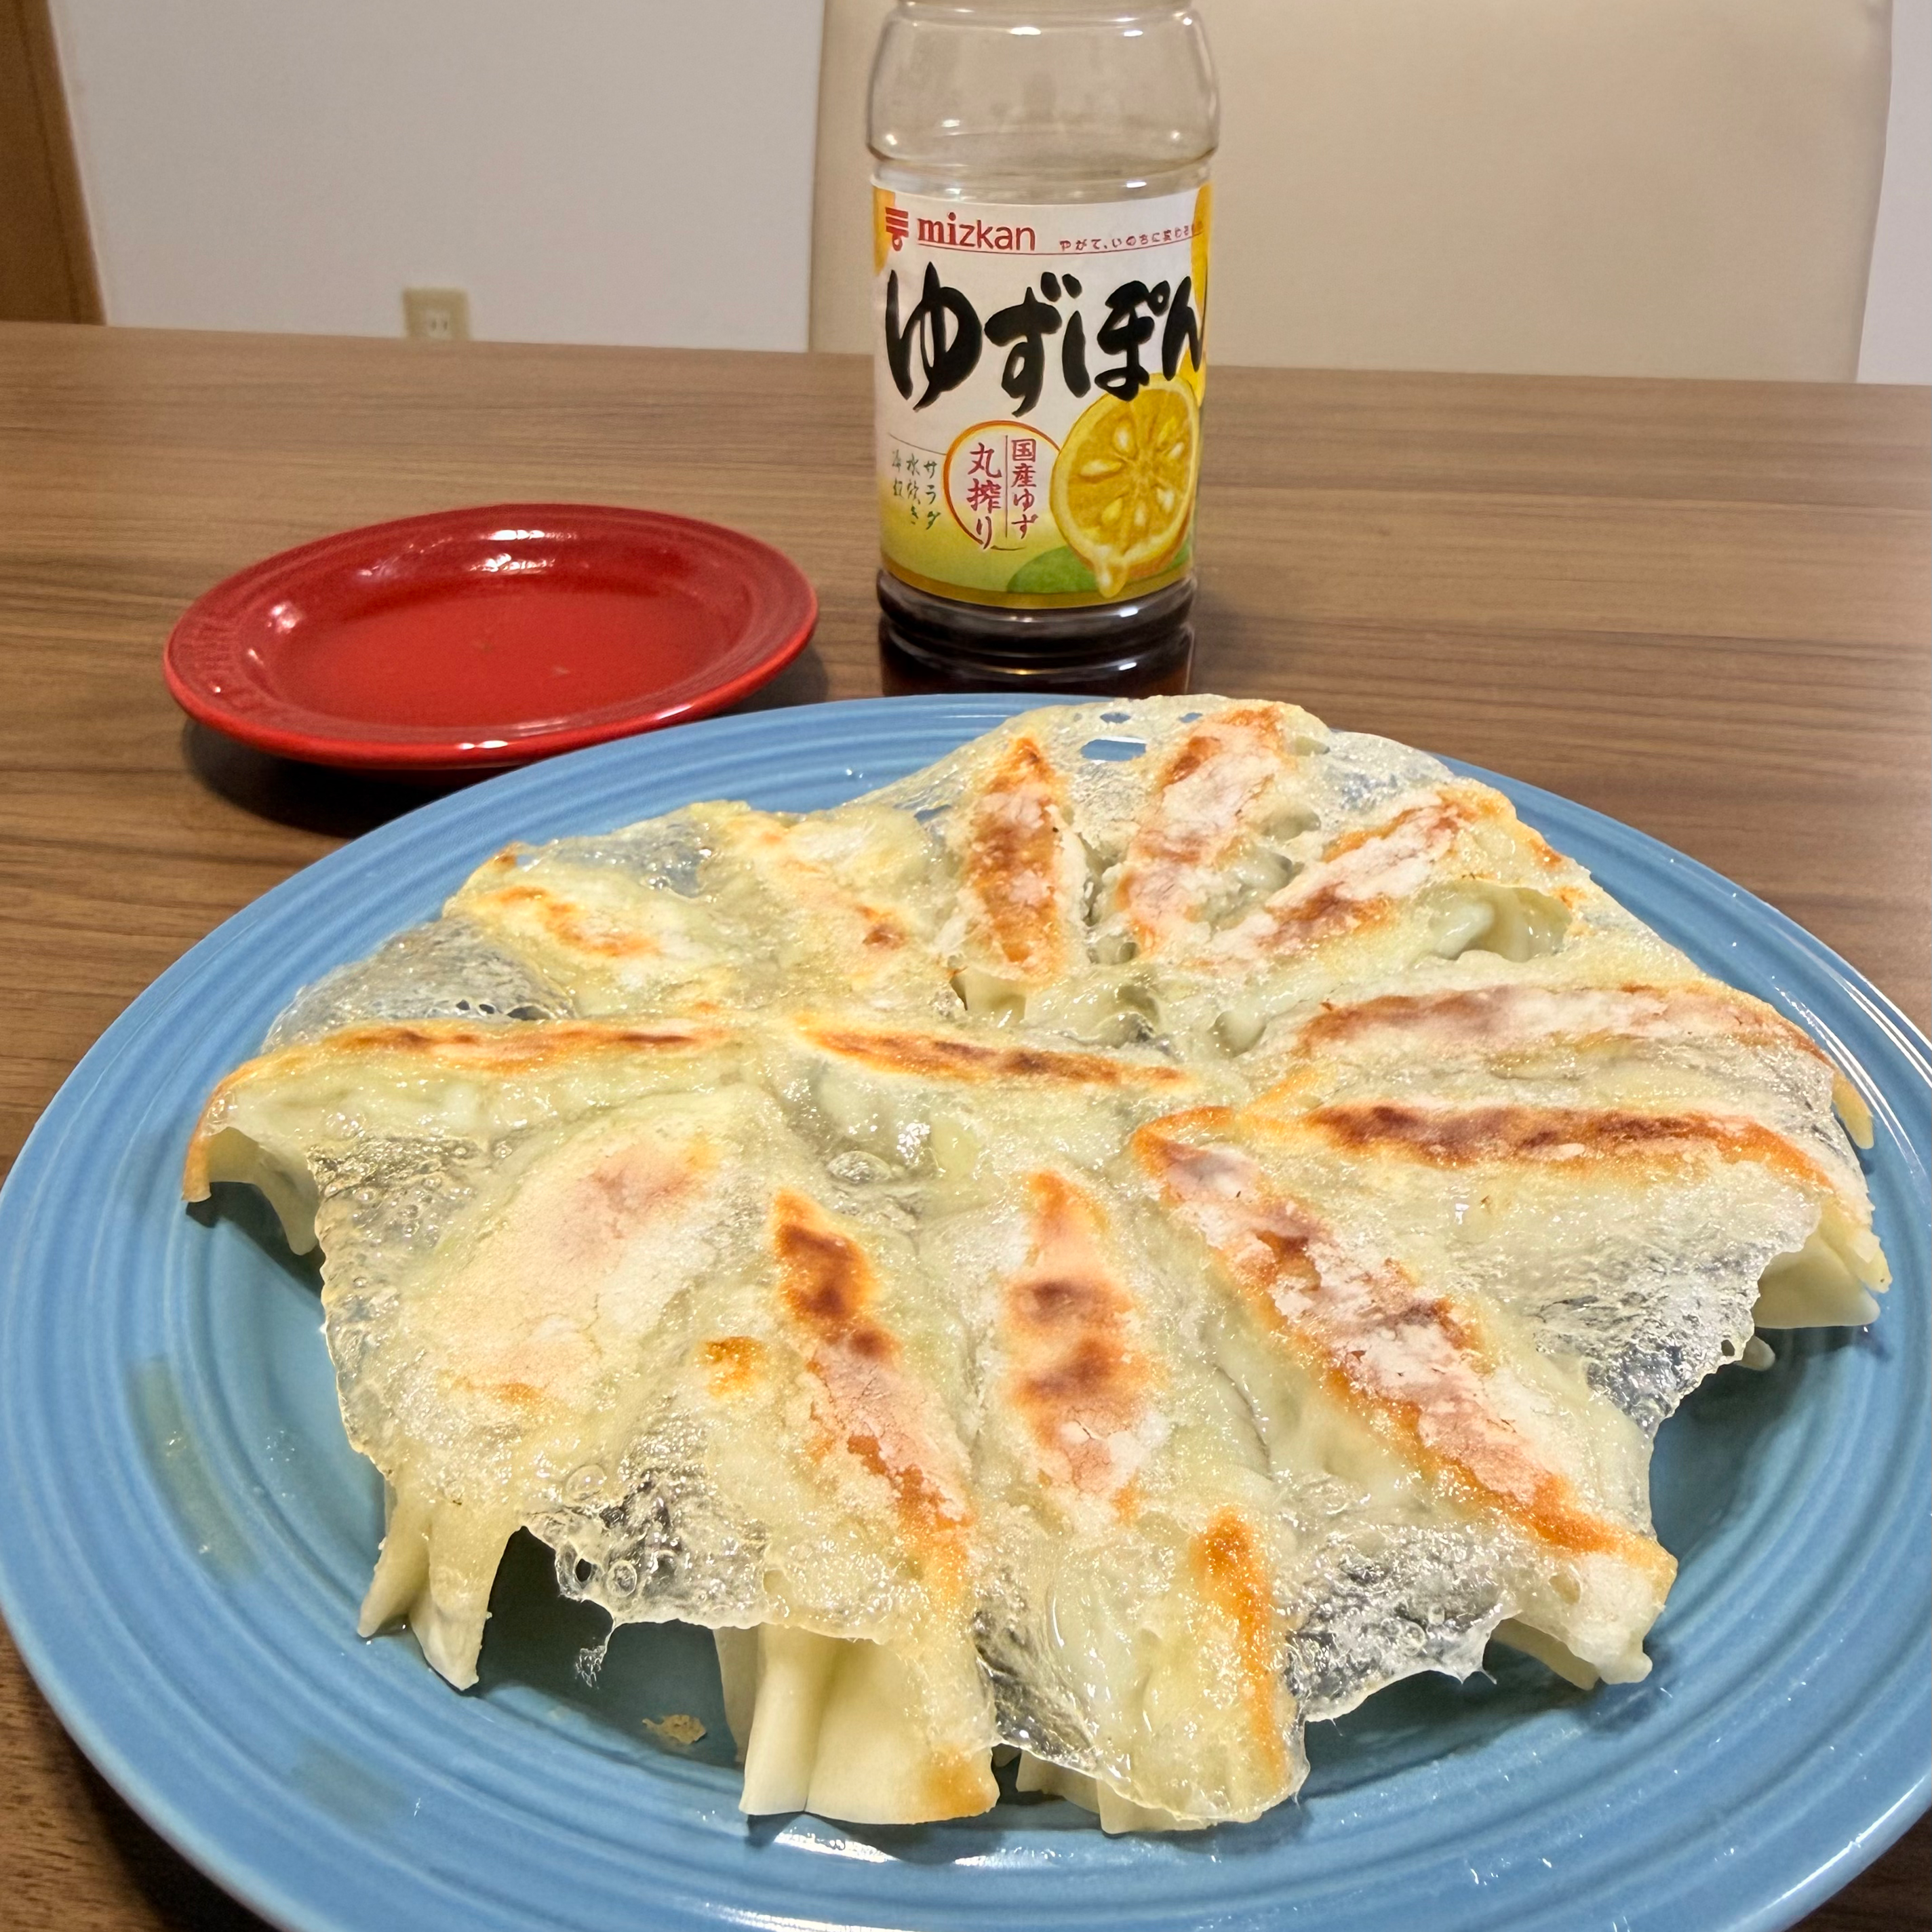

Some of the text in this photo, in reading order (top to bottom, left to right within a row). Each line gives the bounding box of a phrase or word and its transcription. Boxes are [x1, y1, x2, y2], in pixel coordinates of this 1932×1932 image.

[918, 212, 1036, 250] mizkan
[885, 261, 1203, 417] ゆずぽん
[966, 442, 1002, 550] 丸搾り
[1010, 438, 1038, 539] 国産ゆず
